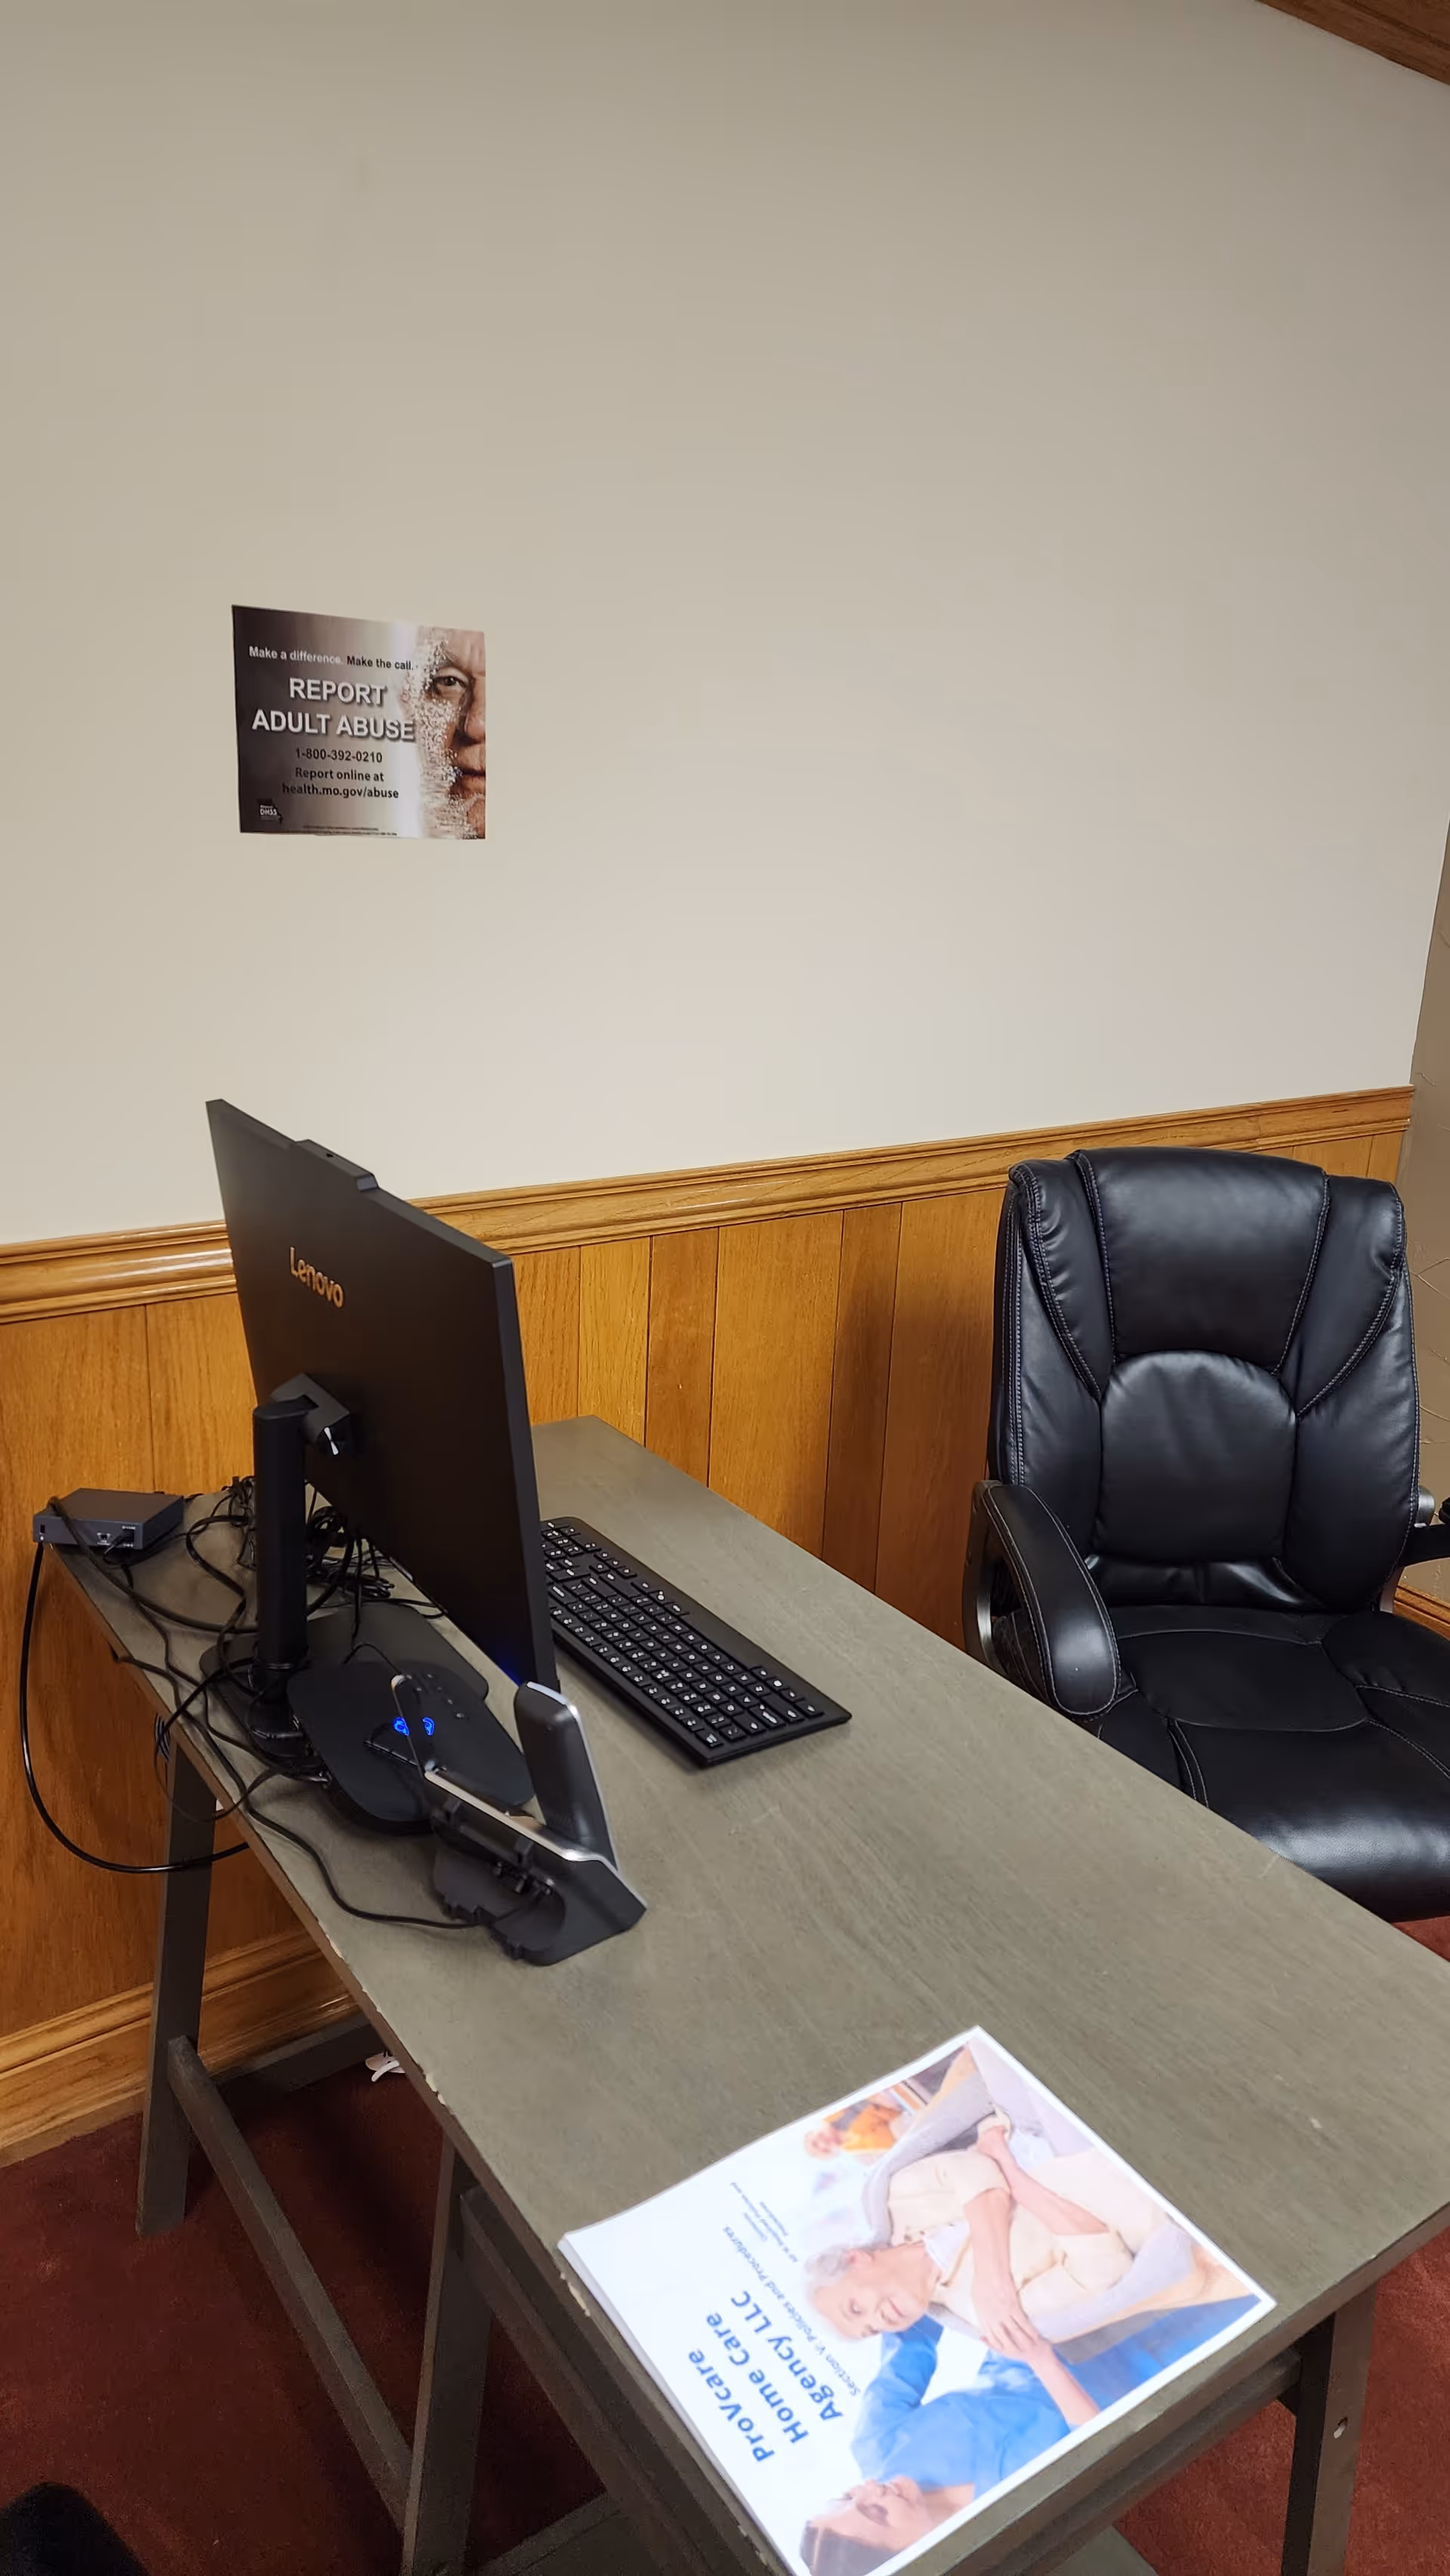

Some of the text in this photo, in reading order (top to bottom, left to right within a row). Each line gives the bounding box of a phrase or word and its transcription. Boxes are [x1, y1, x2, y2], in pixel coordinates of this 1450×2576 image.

[248, 646, 414, 671] Make a difference. Make the call.
[288, 677, 387, 706] REPORT
[251, 709, 416, 741] ADULT ABUSE
[295, 747, 383, 763] 1-800-392-0210
[282, 783, 400, 798] health.mo.gov/abuse
[295, 767, 384, 782] Report online at
[290, 1246, 344, 1308] Lenovo
[764, 2280, 785, 2301] and
[730, 2290, 772, 2334] LLC
[783, 2301, 817, 2342] Policies
[706, 2312, 809, 2444] Home Care
[767, 2336, 844, 2421] Agency
[825, 2355, 861, 2396] Section
[688, 2349, 775, 2462] ProVcare
